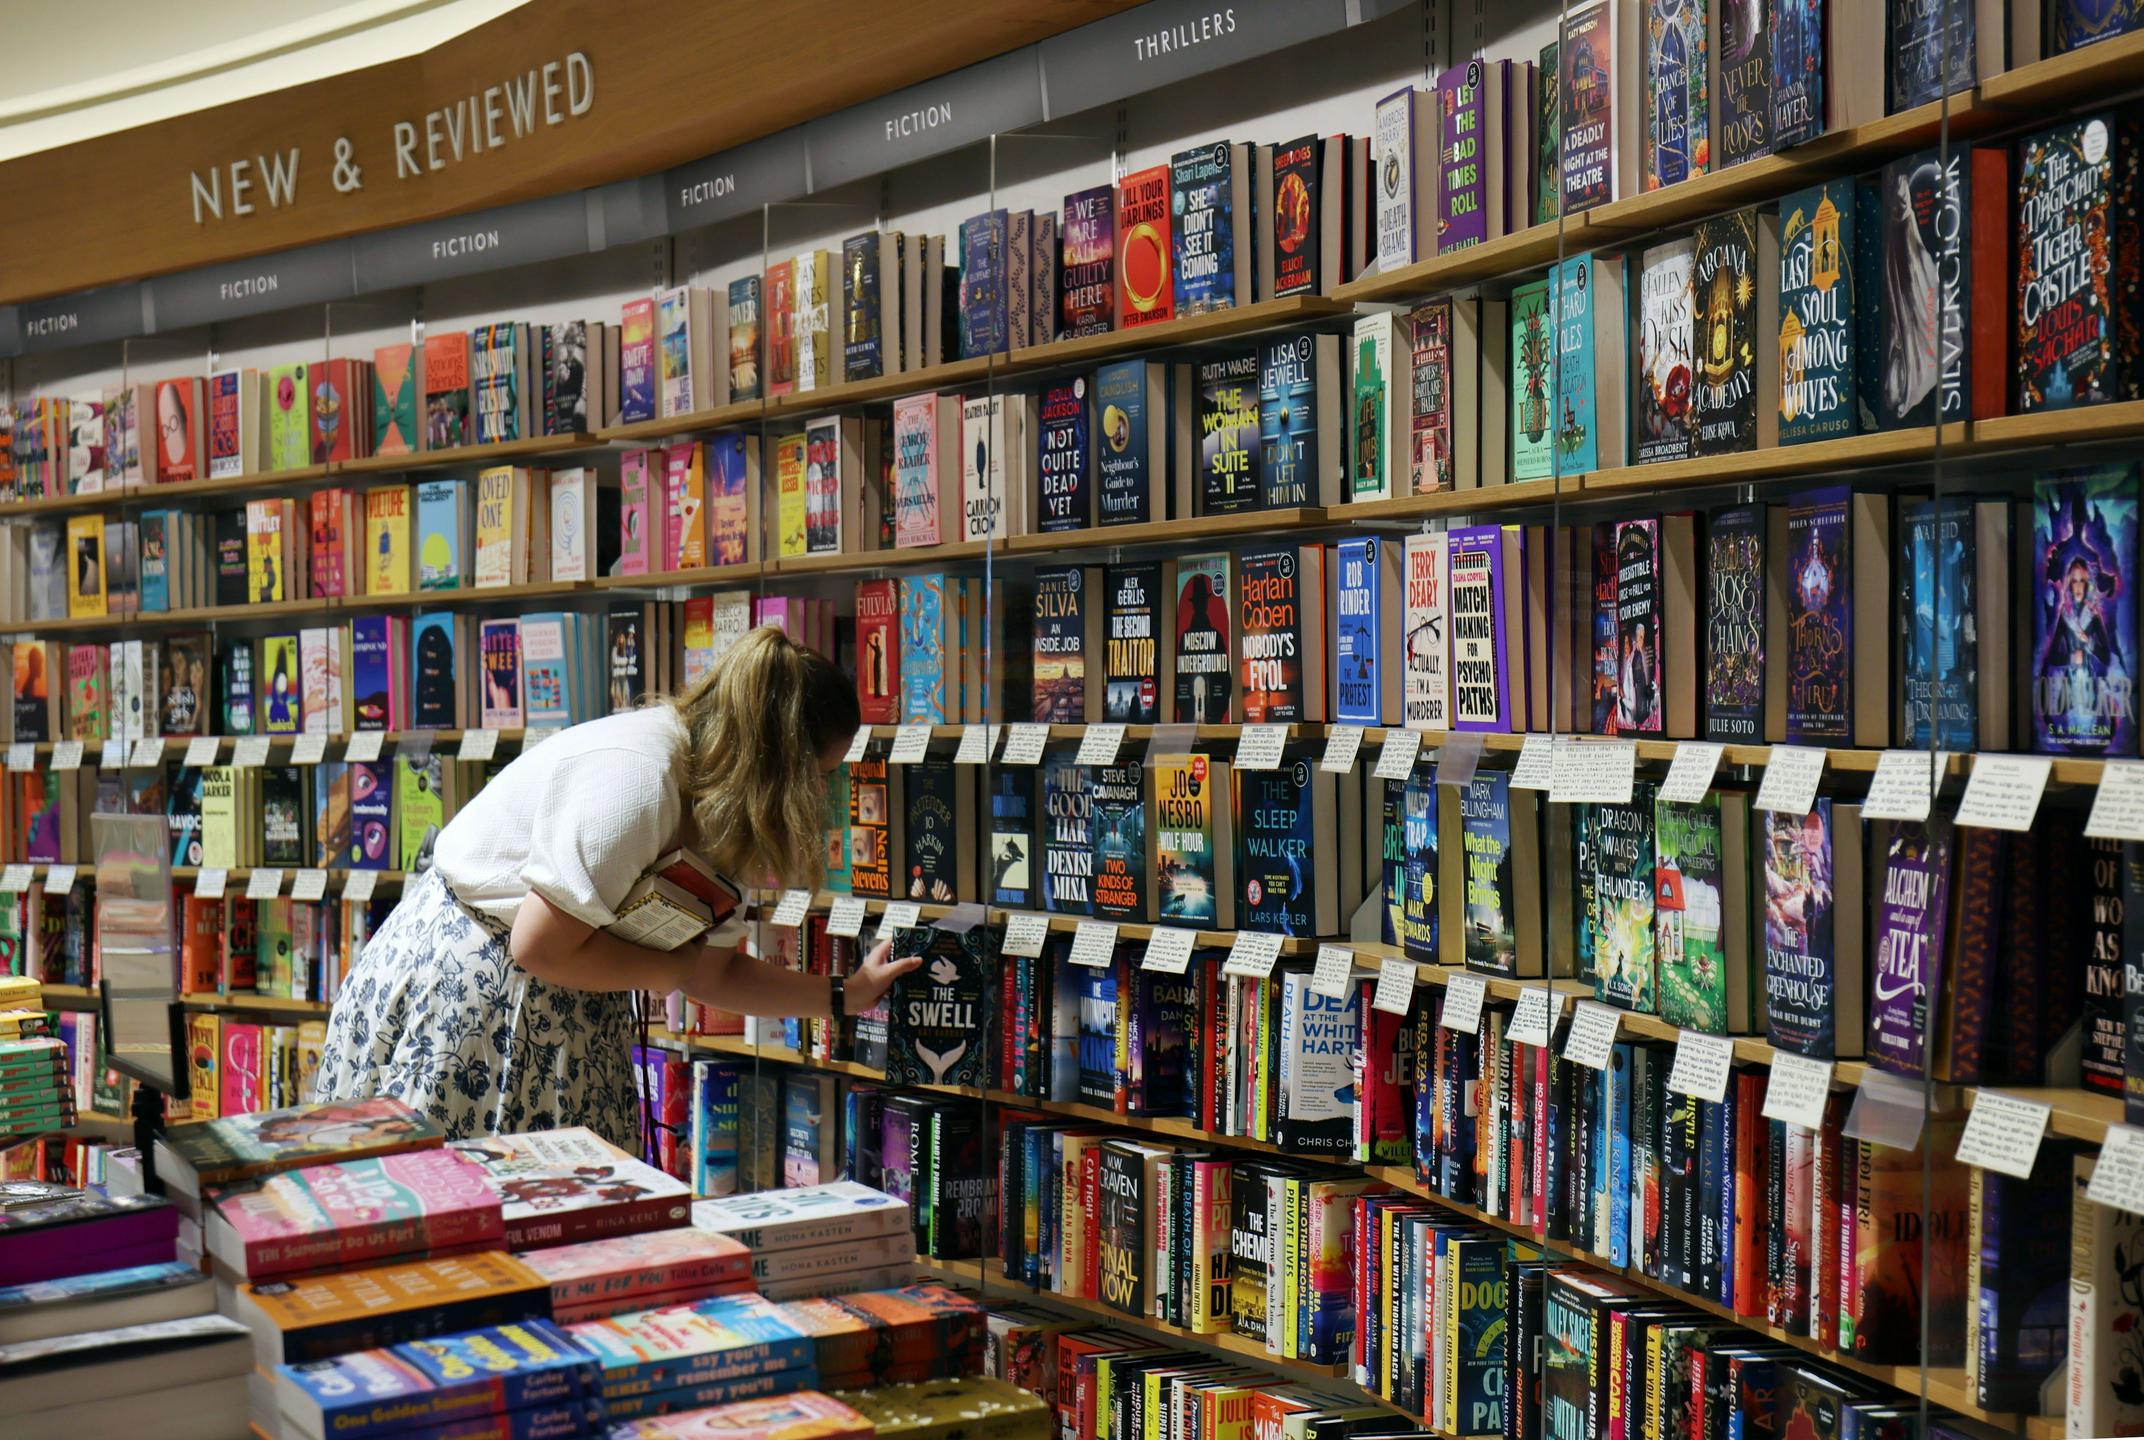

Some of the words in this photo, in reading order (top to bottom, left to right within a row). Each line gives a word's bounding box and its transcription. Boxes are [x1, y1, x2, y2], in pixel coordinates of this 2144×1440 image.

[1134, 8, 1236, 61] THRILLERS
[1659, 69, 1686, 94] DANCE
[1722, 57, 1770, 104] NEVER
[886, 102, 951, 141] FICTION
[1456, 109, 1475, 134] THE
[1775, 97, 1814, 133] MAYER
[191, 148, 299, 223] NEW
[332, 137, 362, 191] &
[394, 51, 595, 179] REVIEWED
[1571, 122, 1605, 148] DEADLY
[1724, 111, 1766, 154] ROSES
[1453, 138, 1475, 163] BAD
[1595, 147, 1608, 161] THE
[1448, 164, 1476, 191] TIMES
[1566, 167, 1603, 193] THEATRE
[2044, 152, 2070, 190] THE
[682, 174, 735, 206] FICTION
[1139, 178, 1164, 200] YOUR
[1189, 188, 1207, 211] SHE
[2022, 166, 2099, 233] MAGICIAN
[1075, 198, 1095, 218] WE
[1451, 191, 1478, 217] ROLL
[1073, 220, 1097, 241] ARE
[1184, 209, 1213, 231] DIDN'T
[432, 230, 499, 259] FICTION
[1186, 237, 1202, 256] SEE
[2033, 223, 2083, 278] TIGER
[1064, 261, 1108, 288] GUILTY
[1182, 253, 1218, 280] COMING
[1699, 243, 1748, 283] ARCANA
[220, 274, 278, 299] FICTION
[1069, 284, 1103, 309] HERE
[2023, 250, 2091, 327] CASTLE
[1076, 313, 1097, 327] KARIN
[1661, 292, 1687, 325] KISS
[1801, 288, 1847, 328] SOUL
[2038, 294, 2083, 344] LOUIS
[27, 313, 78, 336] FICTION
[1271, 343, 1295, 366] LISA
[1785, 328, 1847, 380] AMONG
[2033, 313, 2099, 377] SACHAR
[1202, 364, 1226, 380] RUTH
[1228, 357, 1257, 377] WARE
[1261, 361, 1309, 389] JEWELL
[1216, 388, 1241, 411] THE
[1694, 369, 1751, 415] ACADEMY
[1783, 377, 1839, 419] WOLVES
[1042, 402, 1081, 419] JACKSON
[1202, 406, 1258, 433] WOMAN
[1048, 428, 1074, 449] NOT
[1810, 419, 1849, 433] CARUSO
[1221, 432, 1237, 451] IN
[1267, 441, 1305, 464] DON'T
[1042, 450, 1080, 475] QUITE
[1212, 450, 1249, 474] SUITE
[1276, 463, 1296, 483] LET
[1044, 474, 1078, 496] DEAD
[1267, 486, 1290, 506] HIM
[1049, 496, 1072, 516] YET
[1101, 494, 1139, 512] Murder
[1346, 560, 1362, 588] ROB
[1411, 550, 1436, 579] TERRY
[1618, 560, 1650, 583] IRRESISTIBLE
[1124, 576, 1138, 589] ALEX
[1241, 574, 1292, 604] Harlan
[1409, 580, 1438, 609] DEARY
[857, 598, 894, 617] FULVIA
[1036, 592, 1078, 618] SILVA
[1117, 589, 1145, 606] GERLIS
[1340, 588, 1370, 615] RINDER
[1454, 585, 1488, 613] MATCH
[1124, 614, 1150, 638] SECOND
[1241, 601, 1293, 630] Coben
[1455, 616, 1489, 640] MAKING
[1061, 636, 1080, 651] JOB
[1184, 631, 1217, 650] MOSCOW
[1242, 633, 1295, 659] NOBODY'S
[1467, 643, 1478, 657] FOR
[1108, 638, 1155, 677] TRAITOR
[1177, 653, 1228, 673] UNDERGROUND
[1250, 659, 1287, 692] FOOL
[1457, 661, 1491, 684] PSYCHO
[1340, 683, 1371, 709] PROTEST
[1459, 687, 1493, 716] PATHS
[1407, 700, 1443, 721] MURDERER
[1709, 718, 1728, 734] JULIE
[1730, 719, 1755, 735] SOTO
[1103, 768, 1126, 784] STEVE
[1092, 785, 1138, 801] CAVANAGH
[1262, 780, 1289, 801] THE
[1470, 785, 1490, 800] MARK
[1159, 799, 1203, 829] NESBO
[1254, 808, 1297, 829] SLEEP
[1461, 799, 1505, 820] BILLINGHAM
[1601, 808, 1642, 833] DRAGON
[1056, 817, 1087, 843] LIAR
[1160, 832, 1180, 852] WOLF
[1182, 831, 1204, 853] HOUR
[1406, 821, 1427, 850] TRAP
[915, 834, 945, 856] HARKIN
[1248, 838, 1306, 859] WALKER
[1464, 832, 1485, 853] What
[1487, 833, 1501, 854] the
[1605, 836, 1639, 859] WAKES
[851, 866, 889, 891] Stevens
[1105, 859, 1126, 875] TWO
[1470, 854, 1498, 885] Night
[1053, 875, 1089, 902] MINA
[1098, 874, 1118, 890] KINDS
[1600, 875, 1646, 900] THUNDER
[1095, 890, 1137, 907] STRANGER
[1468, 881, 1501, 911] Brings
[1250, 912, 1270, 924] LARS
[1273, 912, 1307, 926] KEPLER
[1407, 898, 1424, 920] MARK
[1767, 950, 1824, 978] ENCHANTED
[933, 986, 954, 1001] THE
[1766, 975, 1828, 1011] GREENHOUSE
[908, 1002, 976, 1030] SWELL
[1317, 1013, 1338, 1022] THE
[1499, 1050, 1510, 1112] MIRAGE
[910, 1122, 920, 1177] ROME
[1297, 1136, 1333, 1147] CHRIS
[1107, 1152, 1124, 1172] M.W.
[1100, 1170, 1138, 1200] CRAVEN
[629, 1211, 660, 1226] KENT
[1286, 1187, 1294, 1240] PRIVATE
[1684, 1187, 1692, 1228] LINWOOD
[525, 1224, 563, 1242] VENOM
[809, 1224, 853, 1240] KASTEN
[257, 1247, 281, 1265] Till
[284, 1238, 341, 1260] Summer
[1286, 1242, 1294, 1277] LIVES
[1682, 1229, 1690, 1267] BARCLAY
[1099, 1241, 1139, 1283] FINAL
[1100, 1275, 1134, 1306] VOW
[677, 1359, 760, 1384] remember
[764, 1357, 787, 1372] me
